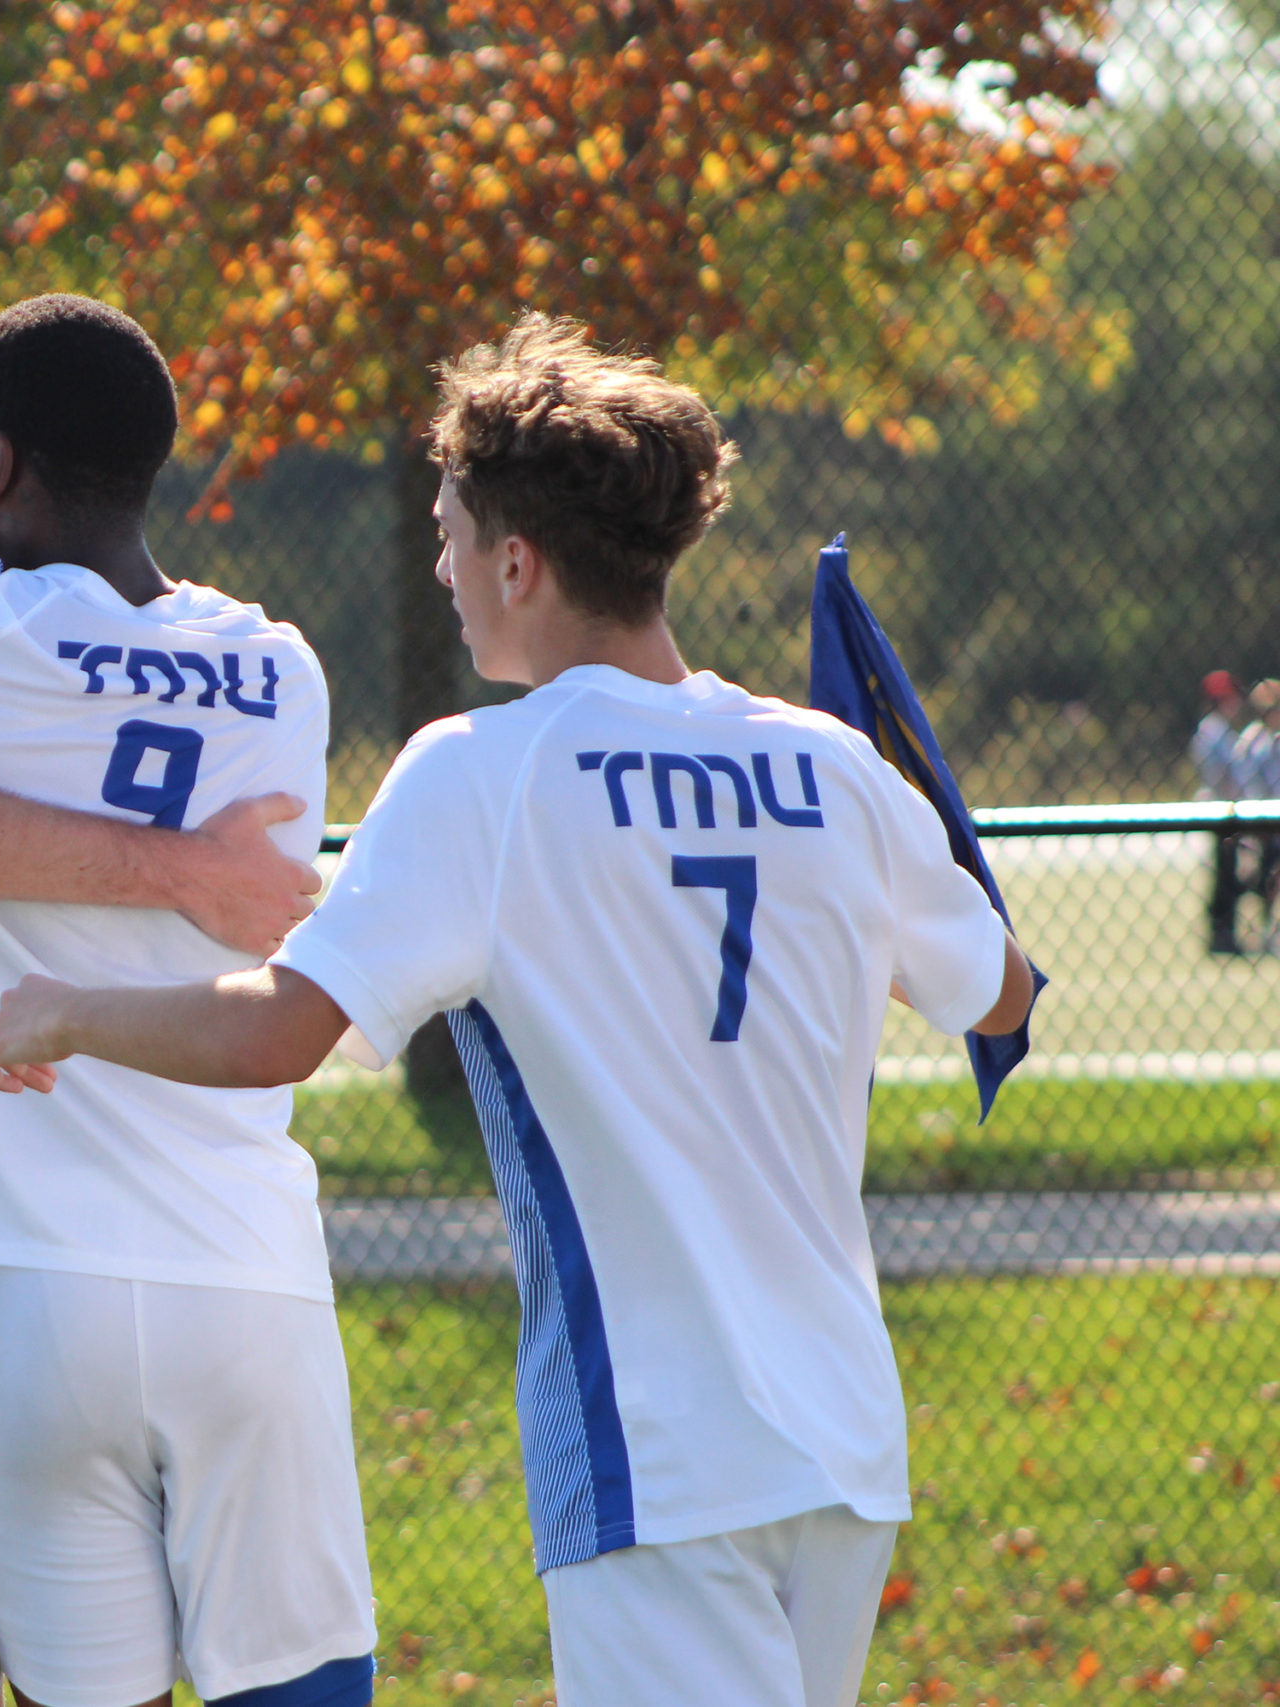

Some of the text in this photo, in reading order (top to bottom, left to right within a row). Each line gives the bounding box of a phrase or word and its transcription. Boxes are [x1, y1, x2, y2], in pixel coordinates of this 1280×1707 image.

[57, 640, 280, 720] TMU
[102, 718, 205, 832] 9
[576, 750, 824, 829] TMU
[671, 854, 758, 1042] 7
